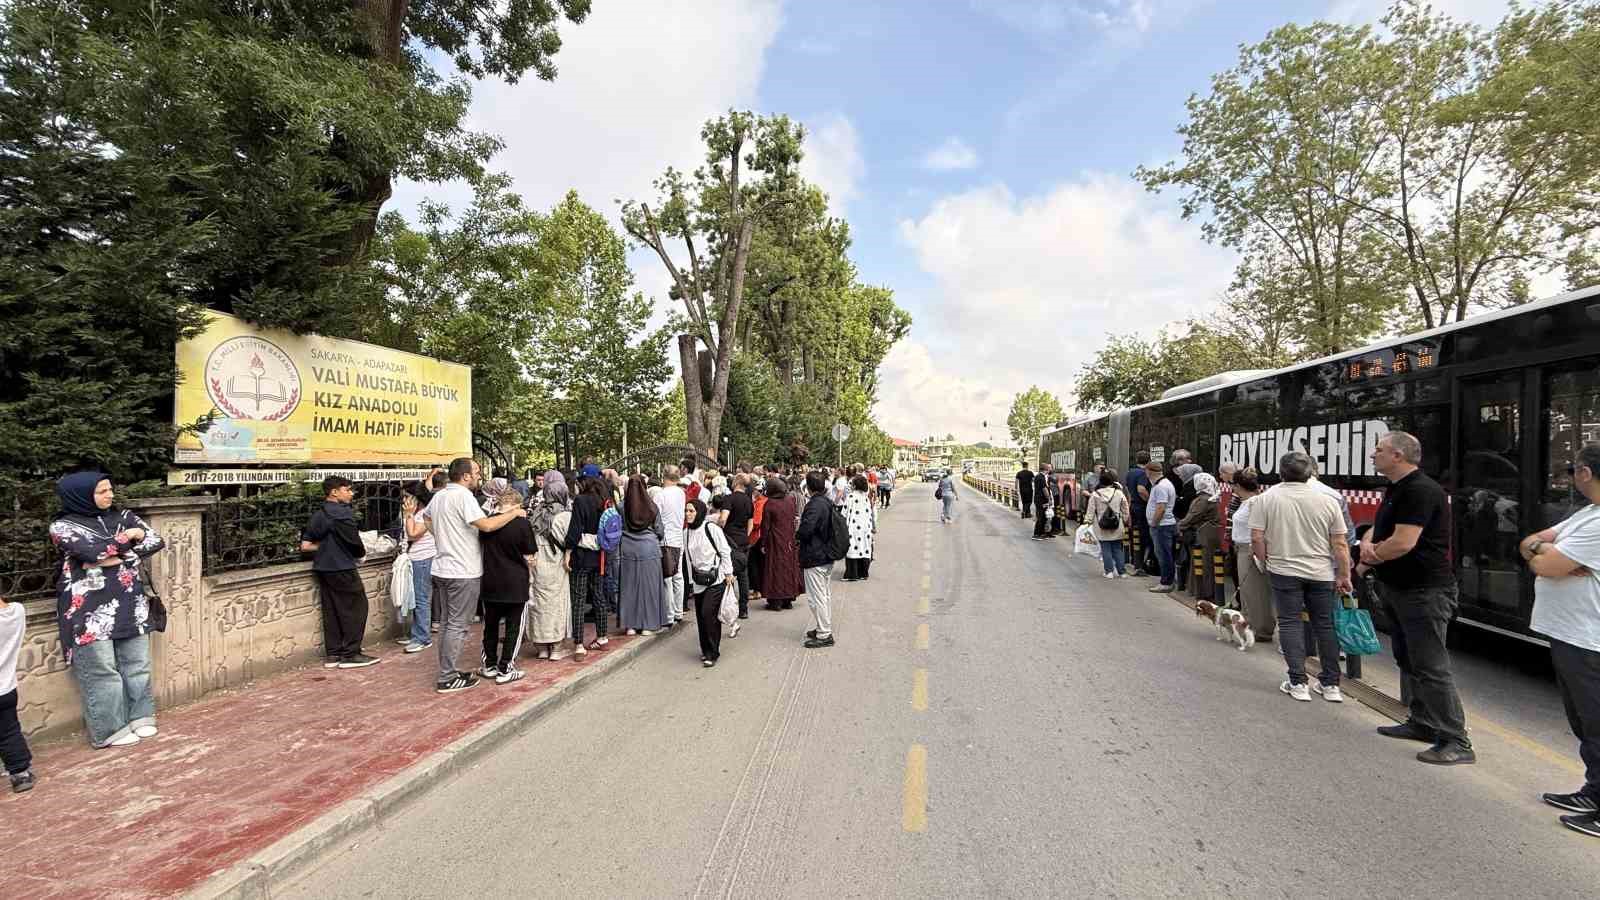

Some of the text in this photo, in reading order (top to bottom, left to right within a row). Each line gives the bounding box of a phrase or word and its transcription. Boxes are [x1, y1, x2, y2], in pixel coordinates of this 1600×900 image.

[311, 349, 355, 367] SAKARYA
[363, 359, 408, 374] ADAPAZARI
[312, 366, 459, 402] VALİ MUSTAFA BÜYÜK
[314, 391, 418, 416] KIZ ANADOLU
[313, 411, 443, 439] İMAM HATİP LİSESİ
[184, 472, 233, 482] 2017-2018
[236, 471, 273, 481] YILINDAN
